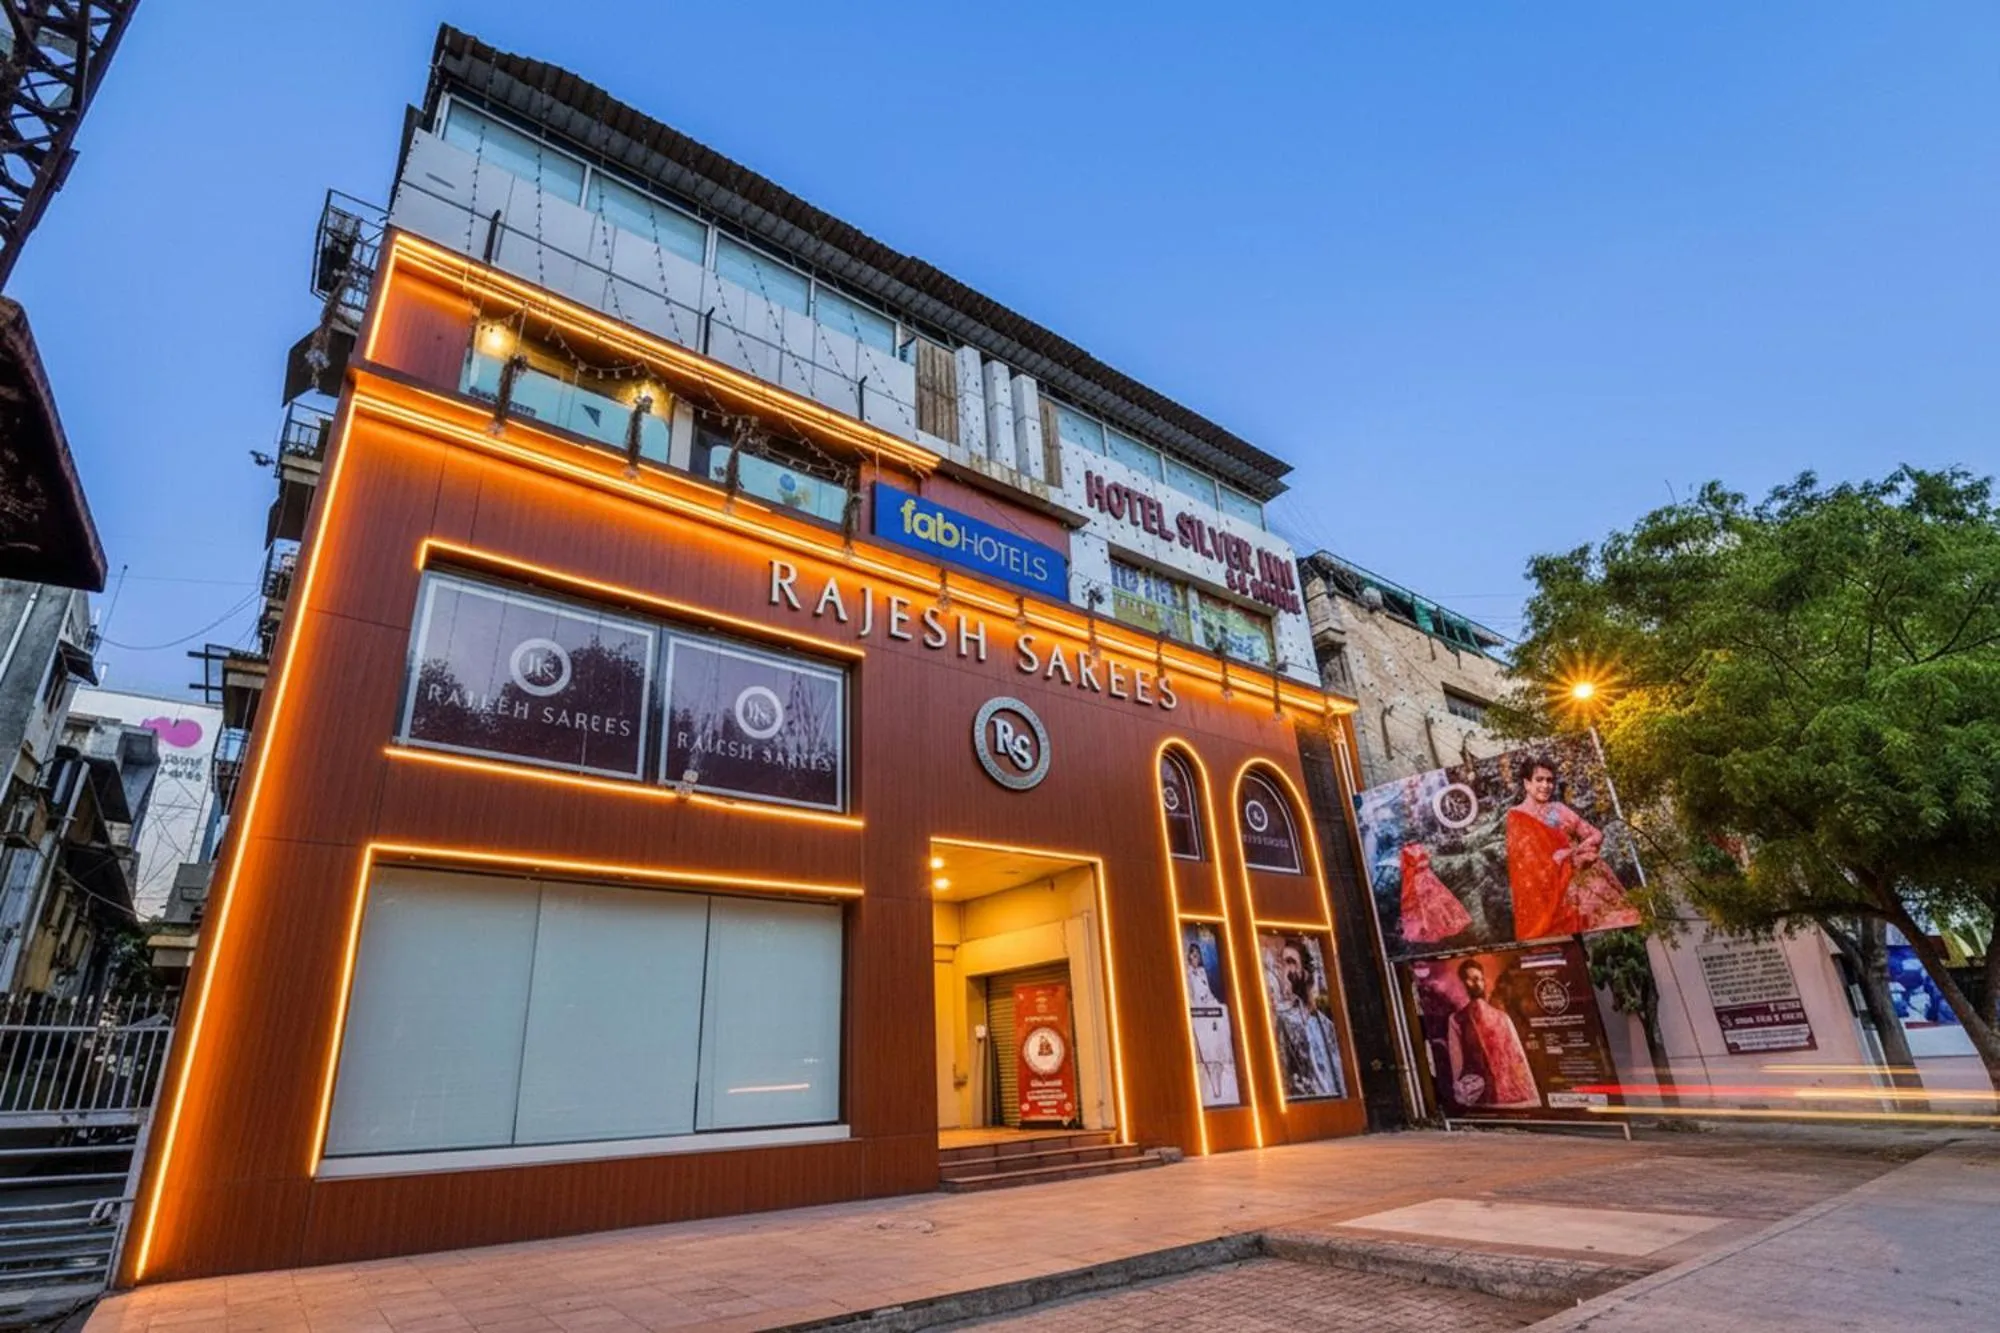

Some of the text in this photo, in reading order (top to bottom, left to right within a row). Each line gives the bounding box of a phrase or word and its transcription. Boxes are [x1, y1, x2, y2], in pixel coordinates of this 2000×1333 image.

[1085, 470, 1175, 542] HOTEL
[1175, 511, 1255, 576] SILVER
[1257, 547, 1295, 591] INN
[769, 560, 987, 661] RAJESH
[1016, 634, 1177, 710] SAREES
[541, 706, 632, 737] SAREES
